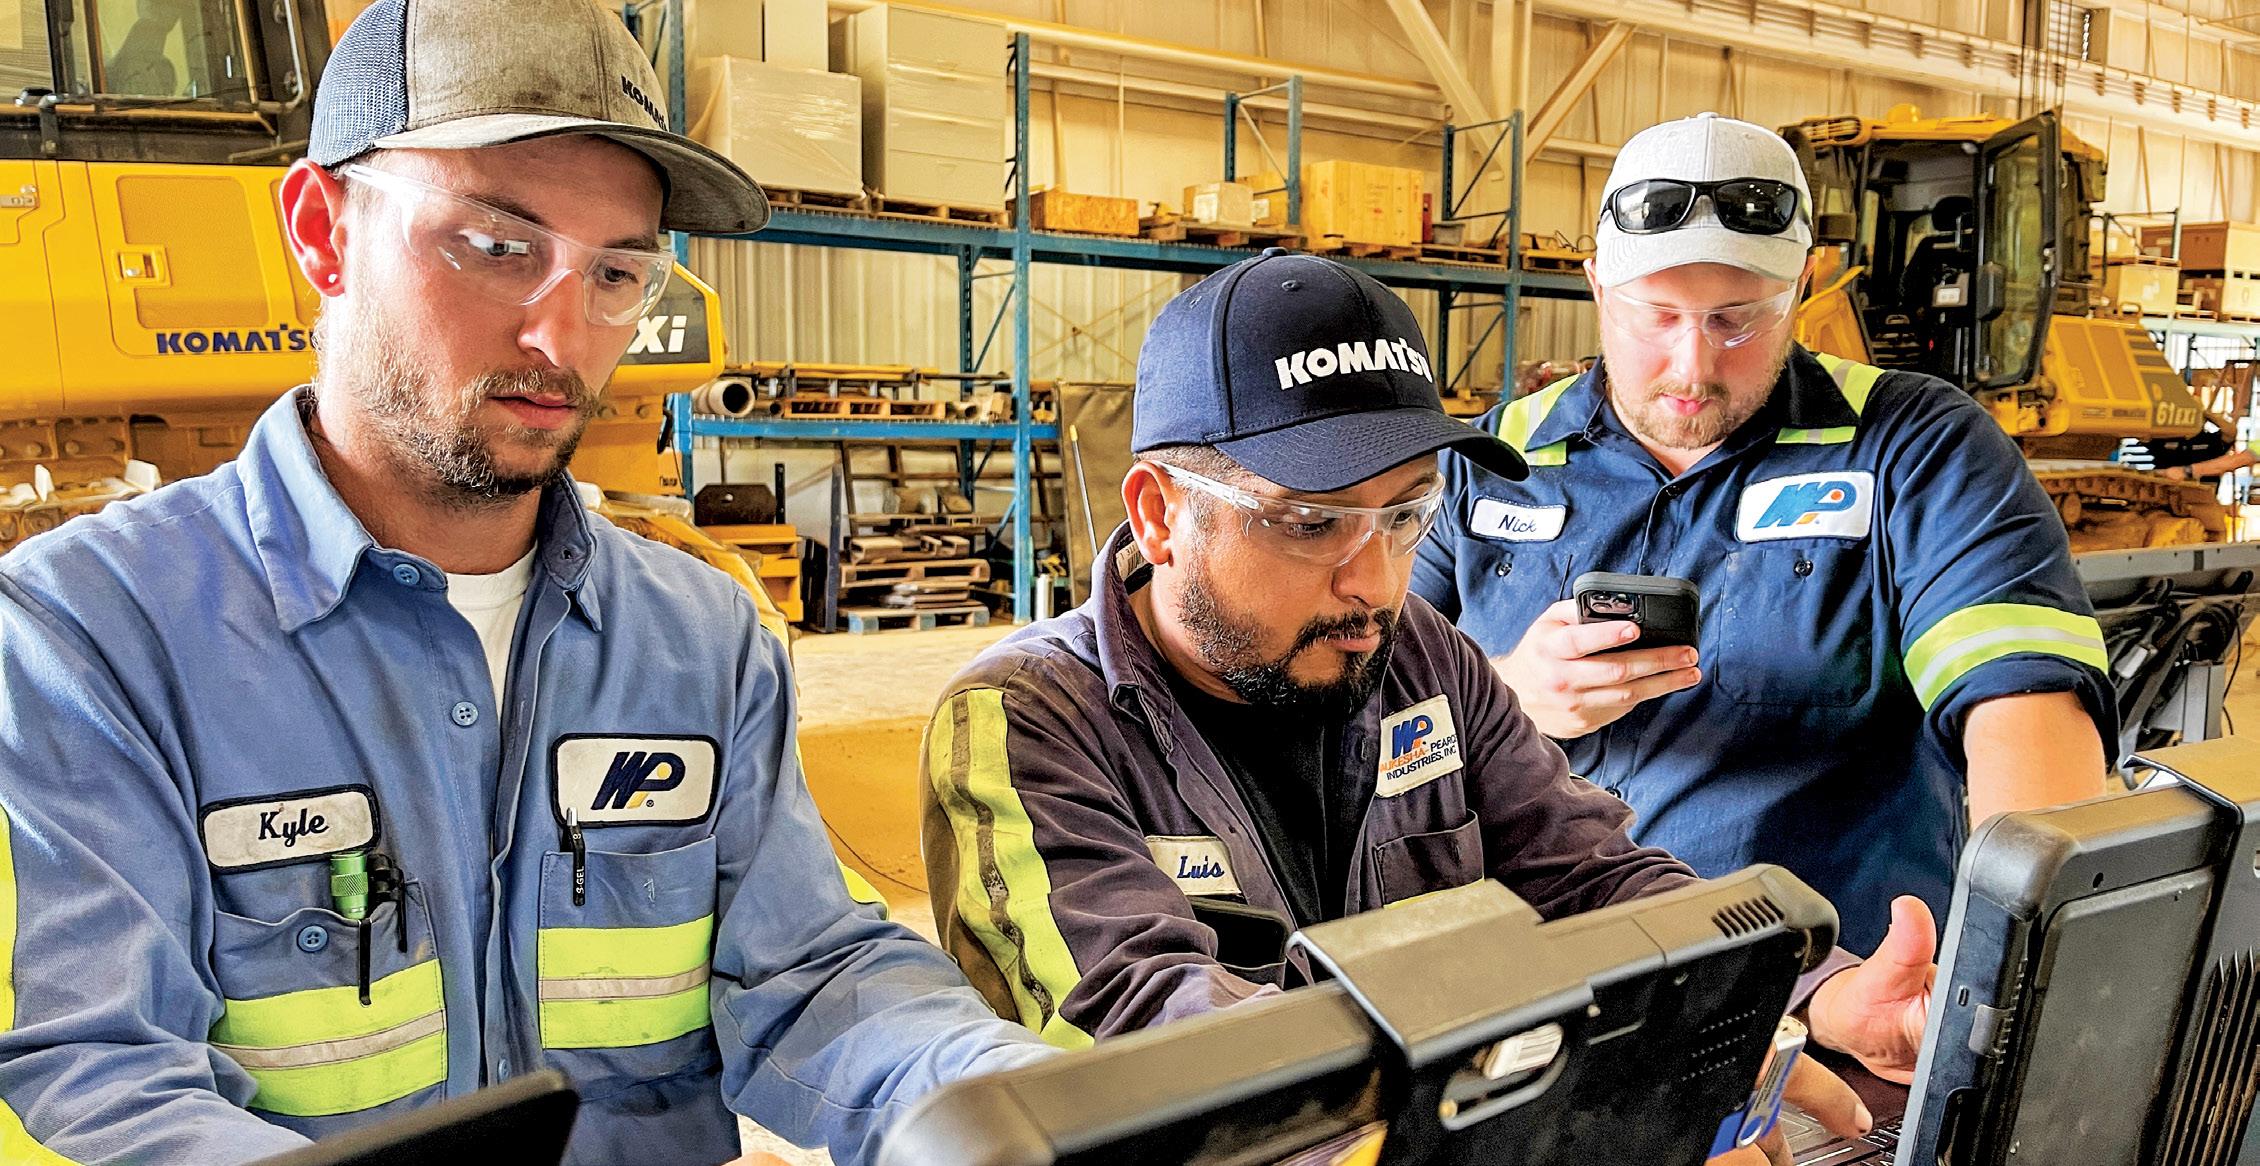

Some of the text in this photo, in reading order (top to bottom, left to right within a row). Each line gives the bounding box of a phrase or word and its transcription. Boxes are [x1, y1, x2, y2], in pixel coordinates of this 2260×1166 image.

[1498, 515, 1537, 532] Nick
[258, 808, 329, 847] Kyle
[1177, 855, 1225, 878] Luis
